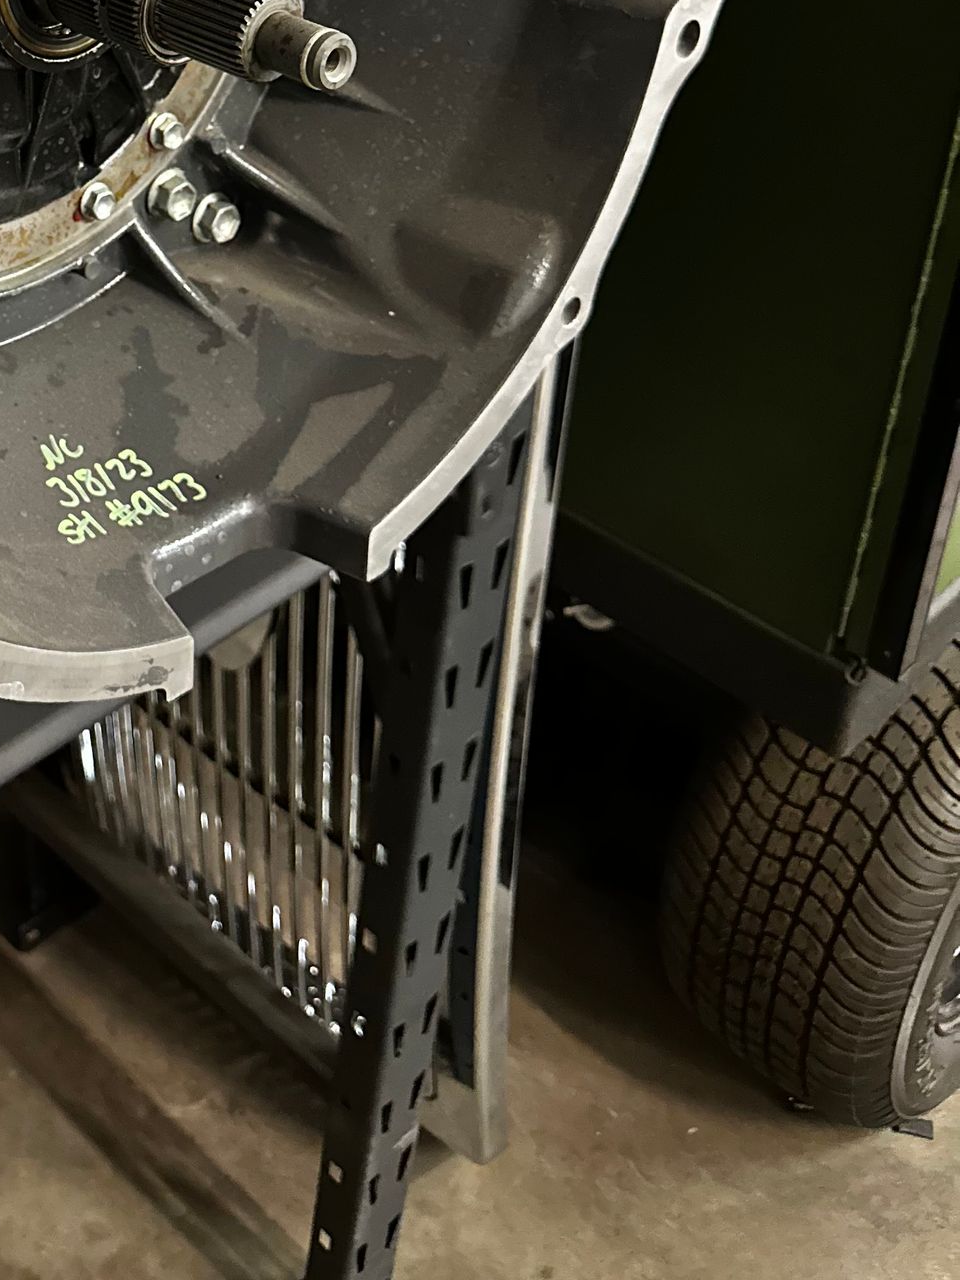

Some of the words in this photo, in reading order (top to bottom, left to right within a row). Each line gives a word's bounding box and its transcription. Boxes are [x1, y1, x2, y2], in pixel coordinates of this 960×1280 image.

[40, 434, 84, 471] NC
[46, 449, 153, 507] 3/8/23
[104, 472, 207, 527] #9173
